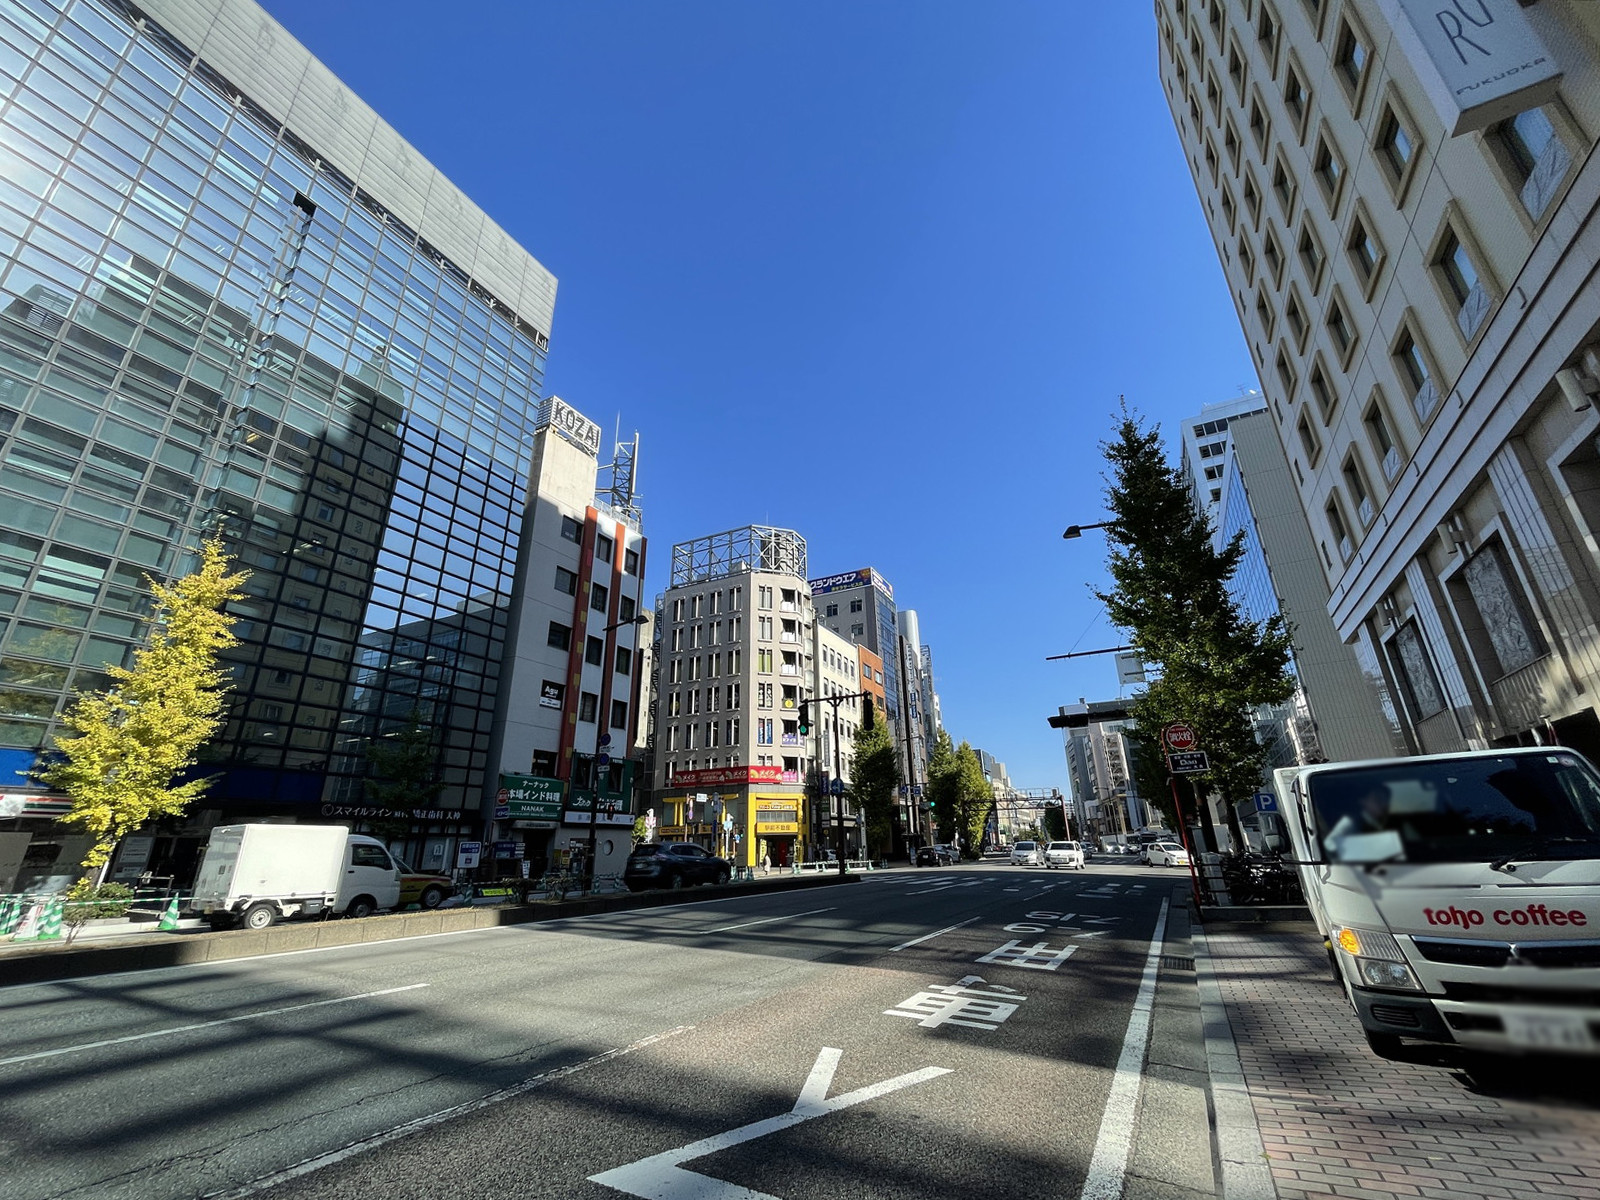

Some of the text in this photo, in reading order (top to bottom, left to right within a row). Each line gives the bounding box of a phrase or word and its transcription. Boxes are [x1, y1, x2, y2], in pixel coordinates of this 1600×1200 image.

[1456, 57, 1546, 95] FUKUOKA
[554, 402, 599, 448] KOZAI
[1168, 731, 1191, 742] 消火栓
[522, 780, 549, 789] ナーナック
[508, 788, 560, 802] 本場インド料理
[1260, 795, 1272, 809] P
[333, 806, 393, 818] スマイルライン
[521, 805, 545, 813] NANAK
[1423, 904, 1587, 930] toho coffee
